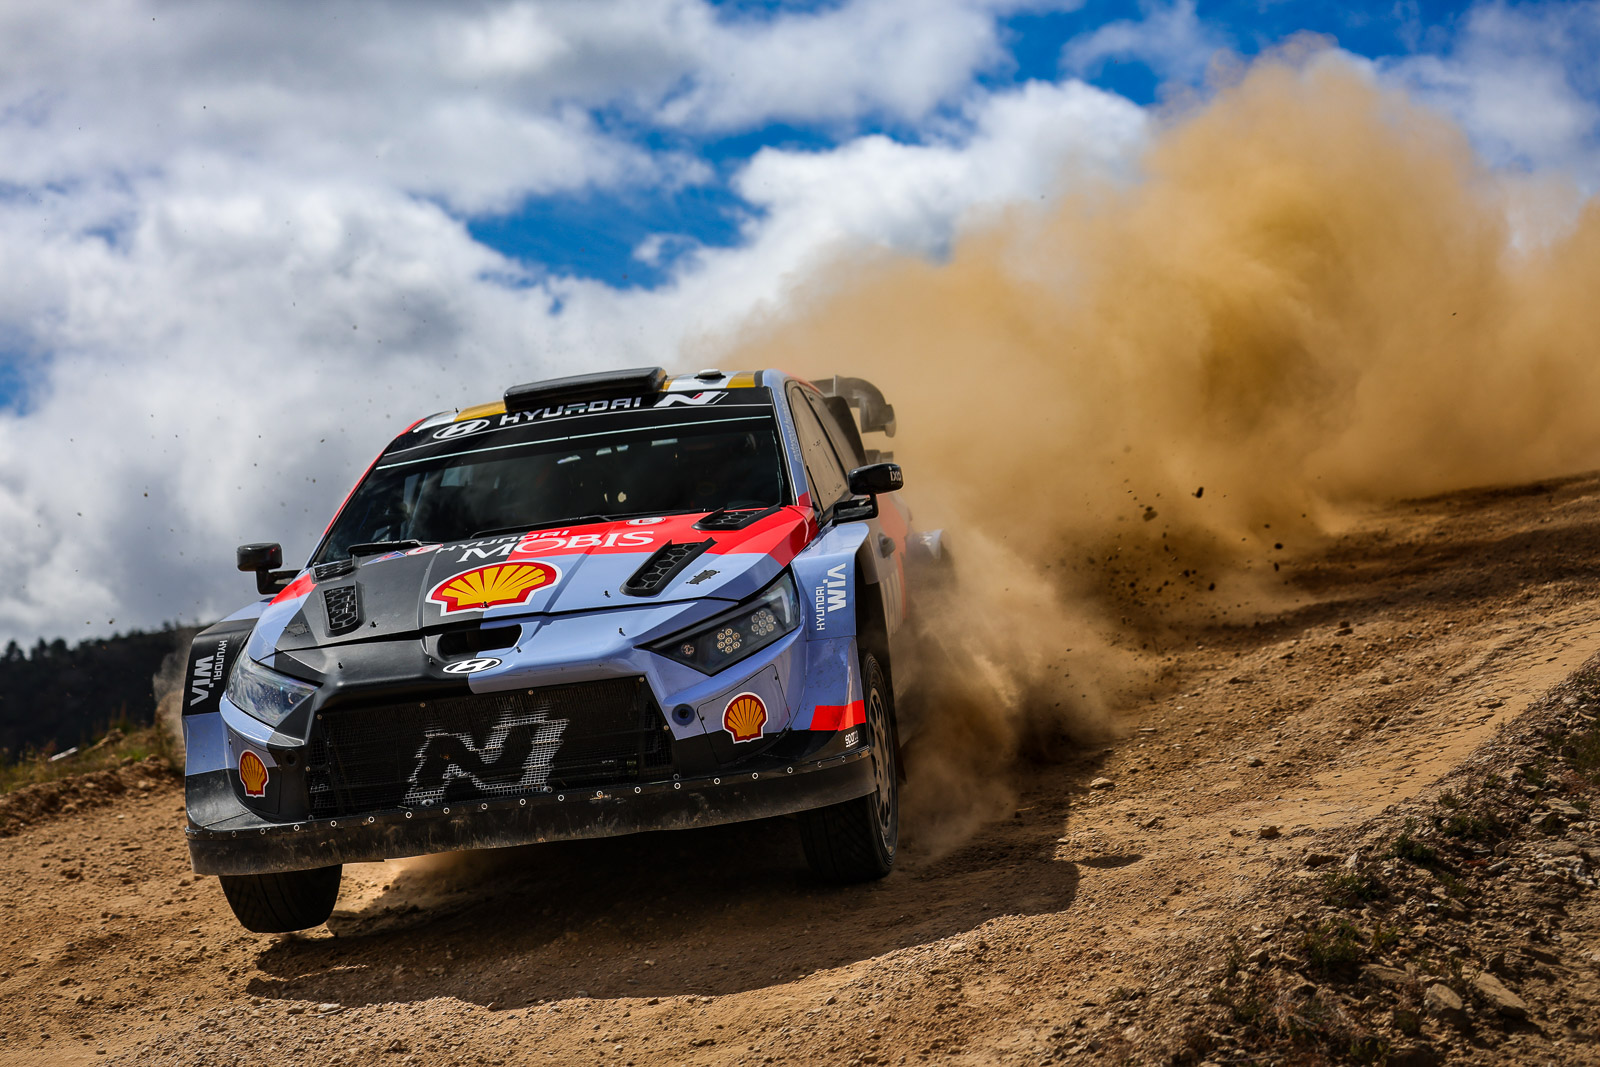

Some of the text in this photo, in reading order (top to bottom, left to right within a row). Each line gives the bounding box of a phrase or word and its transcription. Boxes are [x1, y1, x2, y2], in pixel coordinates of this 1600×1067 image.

[500, 397, 642, 426] HYUNDAI
[436, 530, 569, 555] HYUNDAI
[455, 531, 655, 564] MOBIS
[815, 586, 826, 631] HYUNDAI
[213, 639, 228, 681] HYUNDAI
